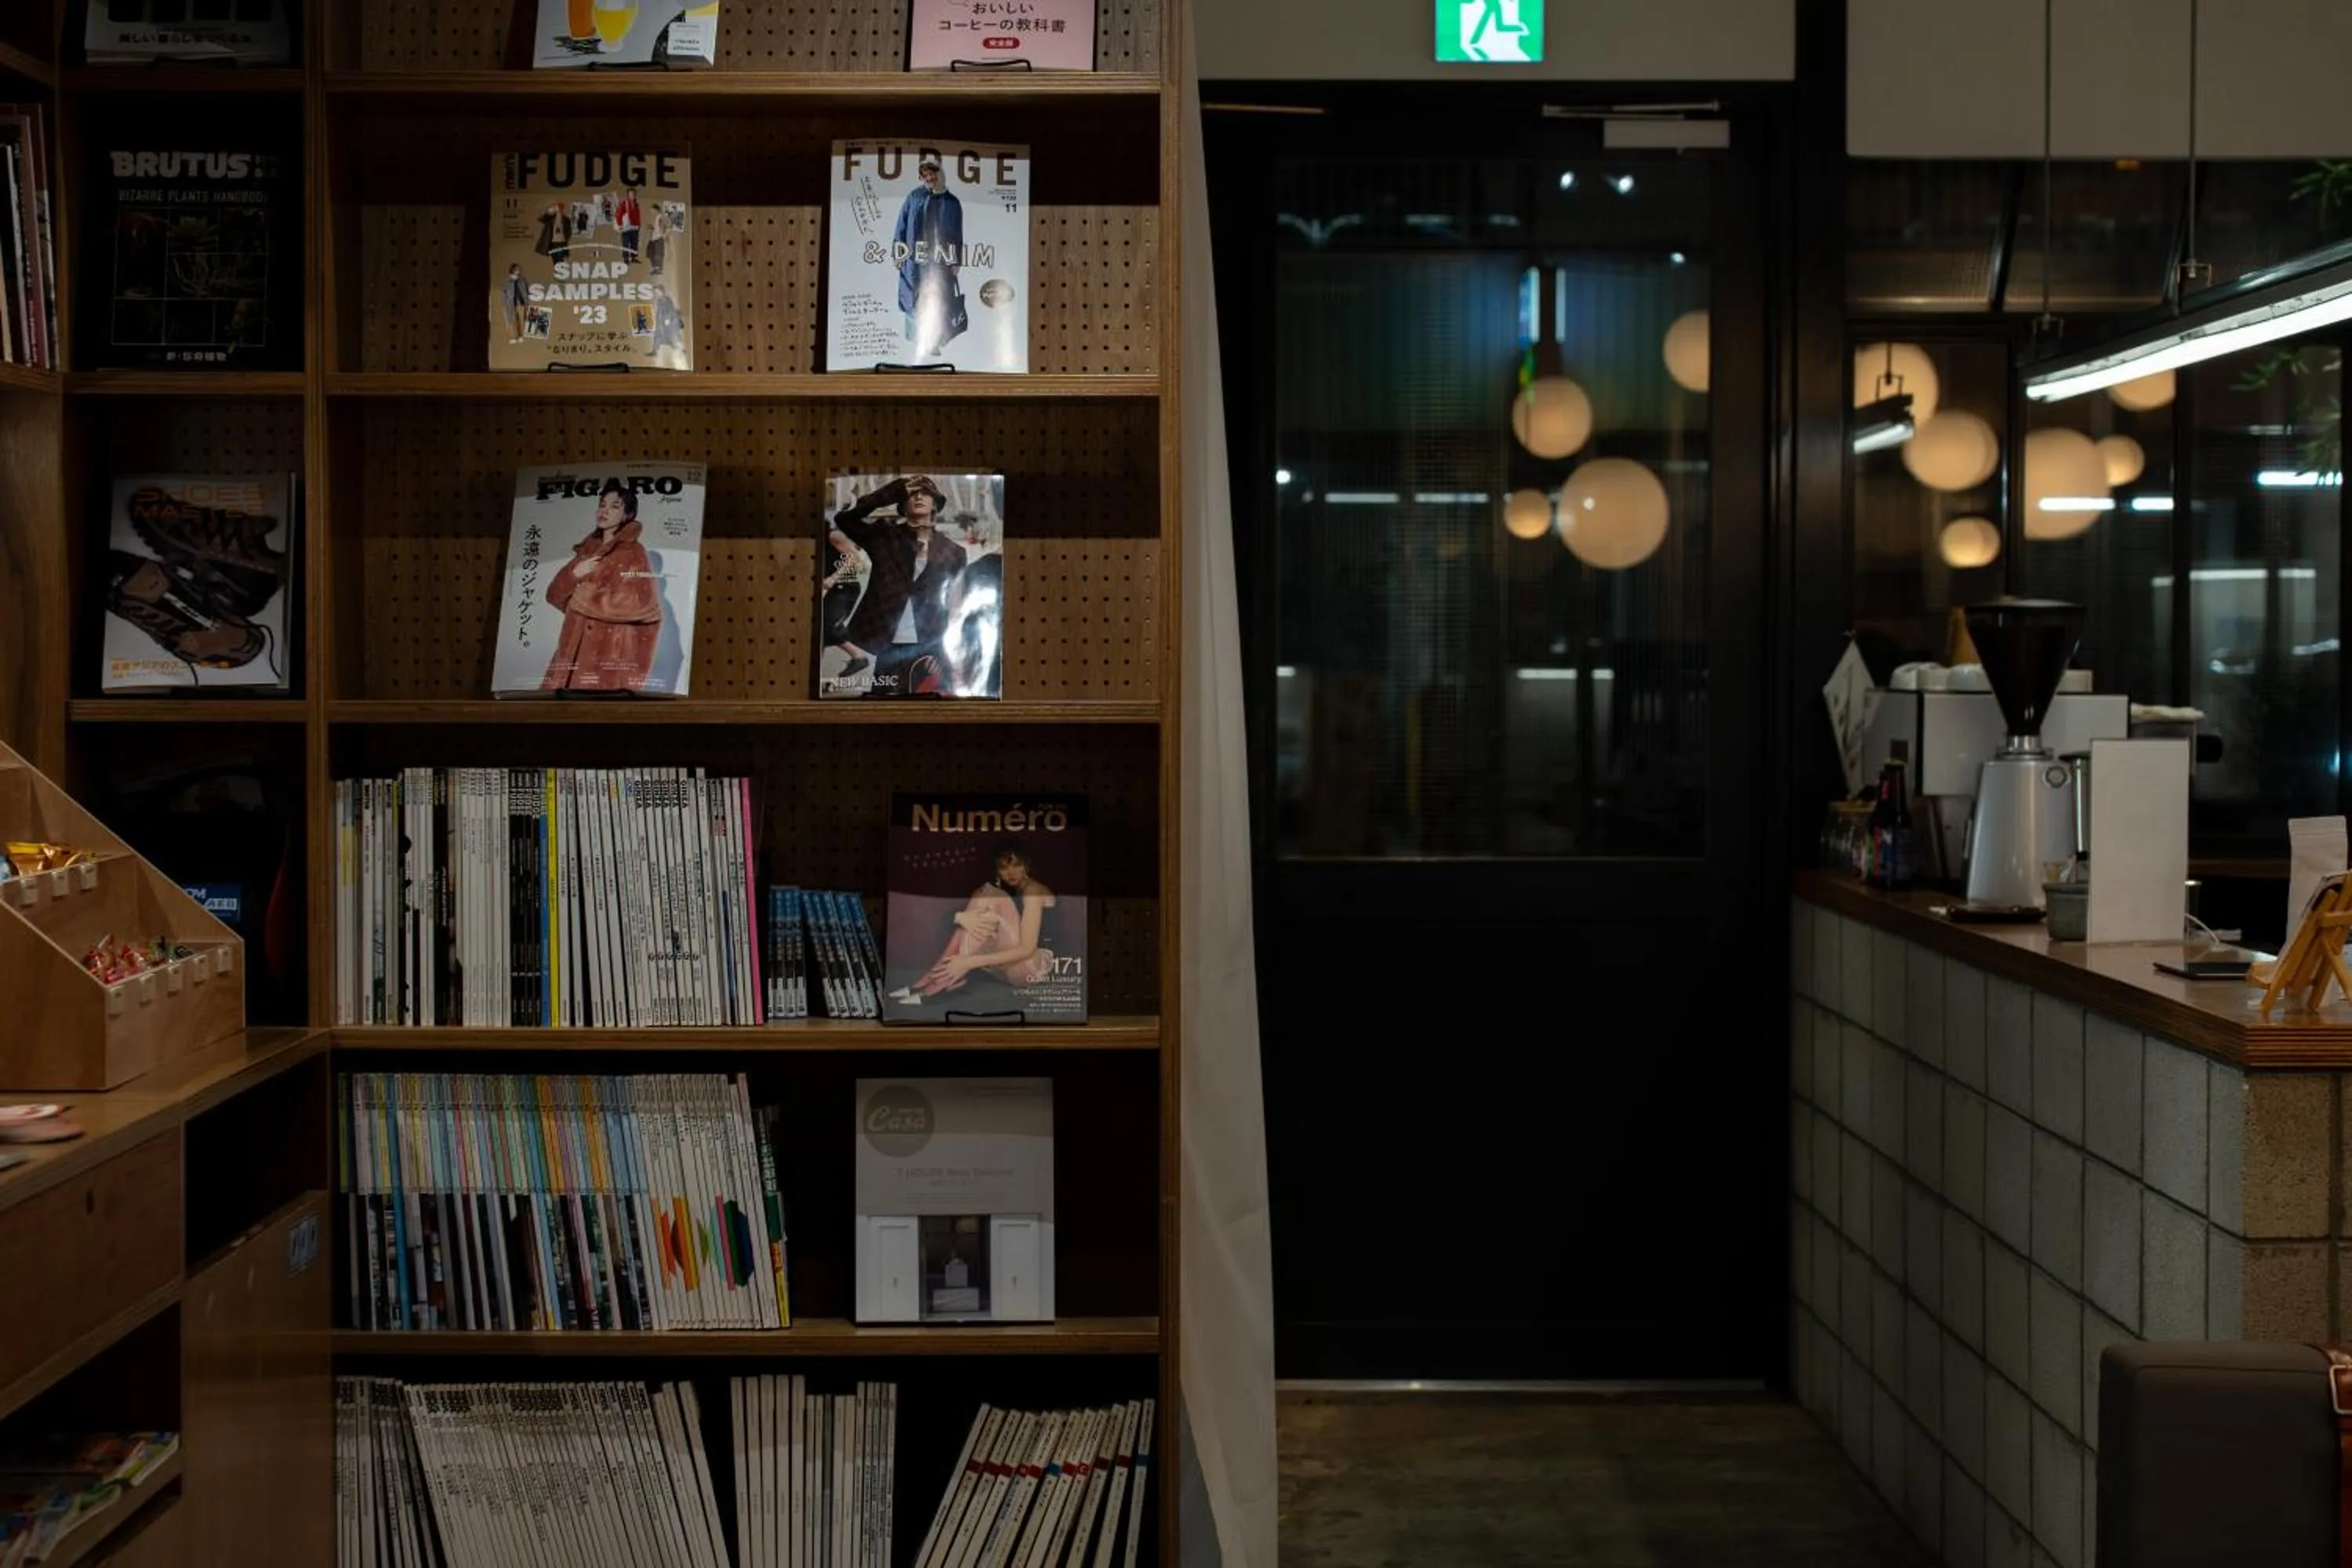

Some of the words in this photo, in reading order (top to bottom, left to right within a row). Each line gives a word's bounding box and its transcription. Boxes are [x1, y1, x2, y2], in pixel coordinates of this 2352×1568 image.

[971, 2, 1034, 14] おいしい
[938, 18, 1066, 33] コーヒーの教科書
[109, 150, 252, 180] BRUTUS
[517, 150, 680, 189] FUDGE
[863, 241, 887, 264] &
[892, 241, 996, 268] DENIM
[553, 261, 629, 280] SNAP
[528, 282, 655, 302] SAMPLES
[557, 332, 629, 343] スナップに学ぶ
[535, 475, 684, 501] FIGARO
[862, 674, 900, 687] BASIC
[911, 802, 1068, 833] Numéro
[1052, 956, 1082, 975] 171
[867, 1105, 927, 1132] Casa
